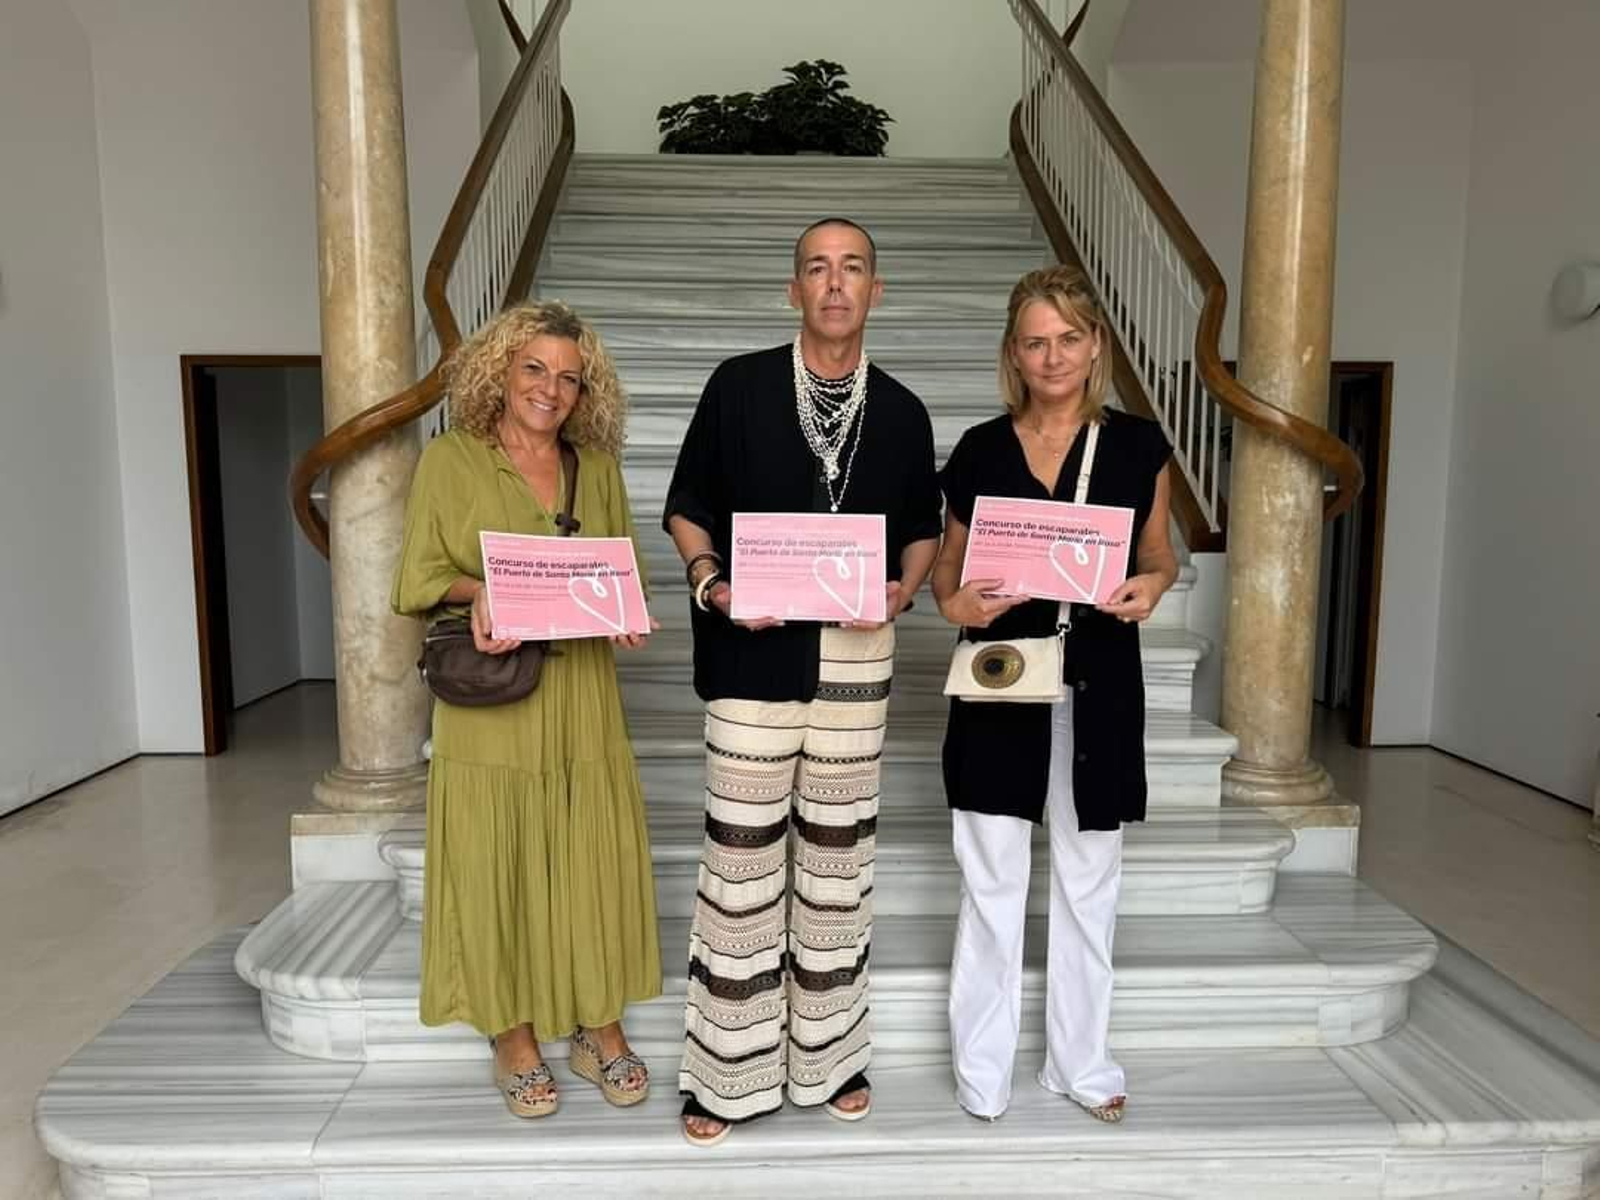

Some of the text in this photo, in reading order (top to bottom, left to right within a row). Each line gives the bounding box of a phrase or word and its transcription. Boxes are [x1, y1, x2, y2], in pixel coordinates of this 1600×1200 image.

[976, 519, 1100, 536] Concurso de escaparates
[988, 529, 1016, 537] Puerto
[1030, 532, 1056, 541] Santa
[736, 537, 858, 548] Concurso de escaparates
[750, 548, 778, 556] Puerto
[780, 548, 790, 556] de
[488, 556, 609, 570] Concurso de escaparates
[503, 567, 531, 577] Puerto
[532, 569, 543, 577] de
